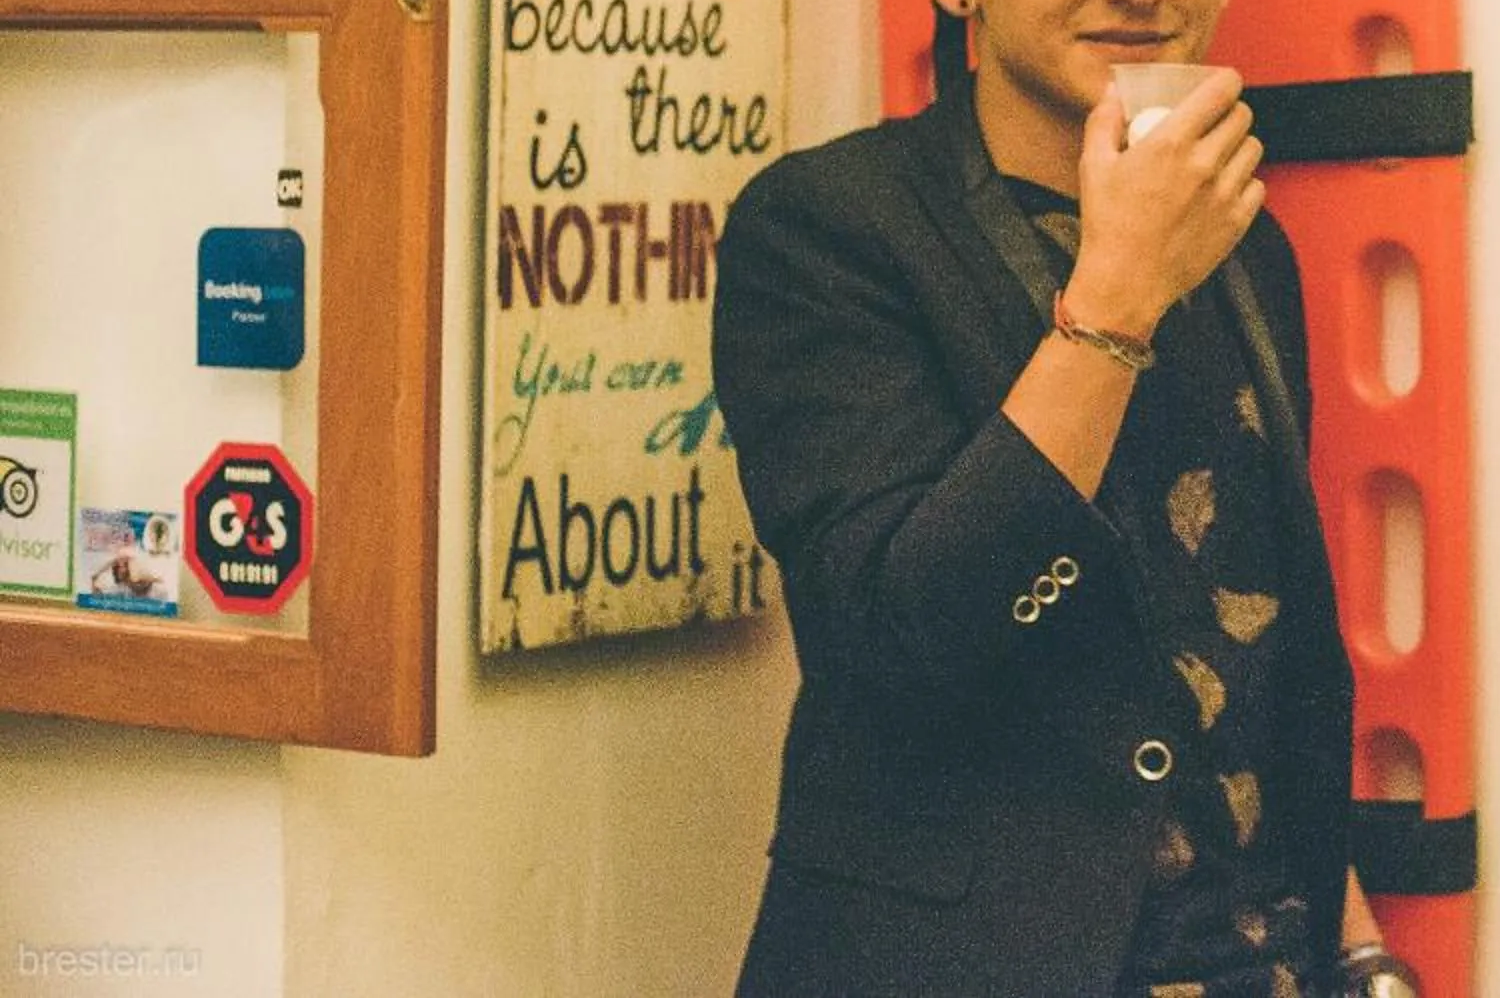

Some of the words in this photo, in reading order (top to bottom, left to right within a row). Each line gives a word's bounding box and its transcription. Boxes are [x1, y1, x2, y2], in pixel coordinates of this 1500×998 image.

[529, 109, 588, 190] is
[625, 63, 771, 154] there
[497, 201, 719, 310] NOTHIN
[502, 463, 706, 599] About
[731, 541, 764, 615] it
